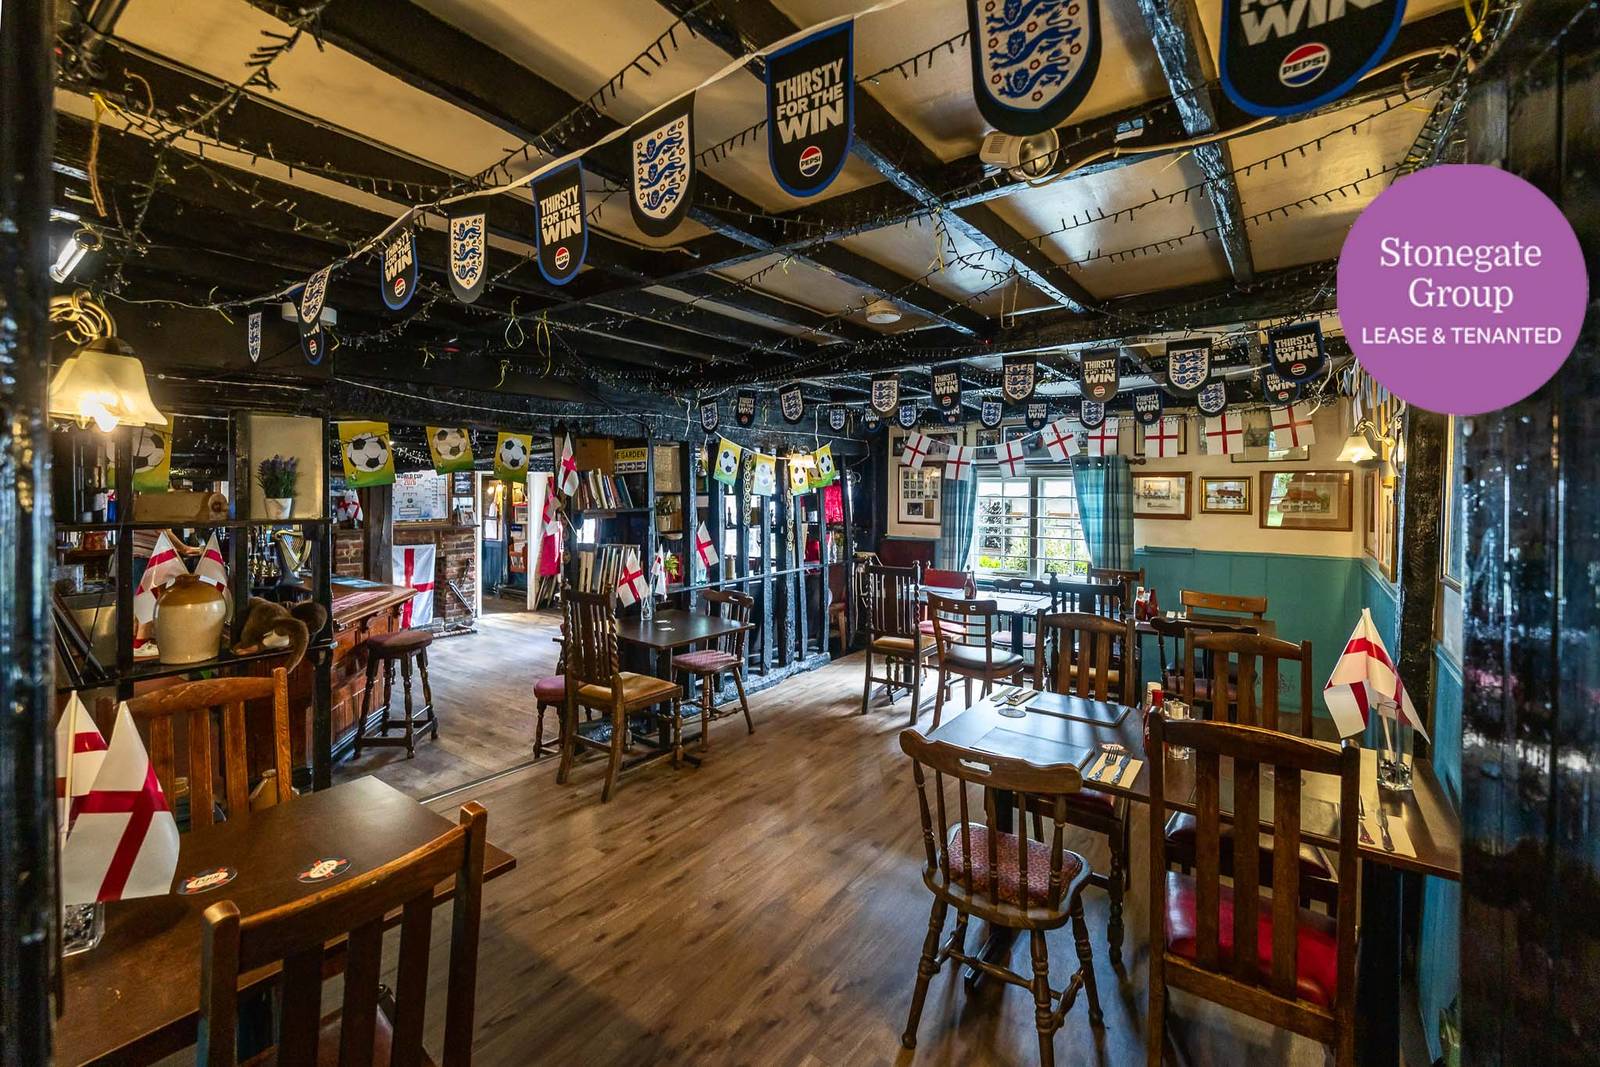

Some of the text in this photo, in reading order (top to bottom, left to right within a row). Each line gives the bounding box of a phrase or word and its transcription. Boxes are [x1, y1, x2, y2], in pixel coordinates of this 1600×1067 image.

[1282, 55, 1327, 76] PEPSI
[776, 58, 844, 104] THIRSTY
[776, 82, 844, 120] FOR THE
[777, 99, 844, 145] WIN
[801, 156, 821, 168] PEPSI
[540, 185, 579, 217] THIRSTY
[541, 203, 580, 229] FOR THE
[542, 214, 581, 246] WIN
[385, 241, 411, 271] FOR THE
[385, 250, 413, 282] WIN
[1274, 333, 1315, 348] THIRSTY
[1275, 342, 1317, 354] FOR THE
[1276, 348, 1319, 363] WIN
[1084, 359, 1116, 370] THIRSTY
[1085, 373, 1116, 384] WIN
[935, 385, 959, 395] WIN
[1267, 382, 1297, 392] WIN
[1136, 404, 1160, 412] WIN
[621, 450, 646, 459] GARDEN
